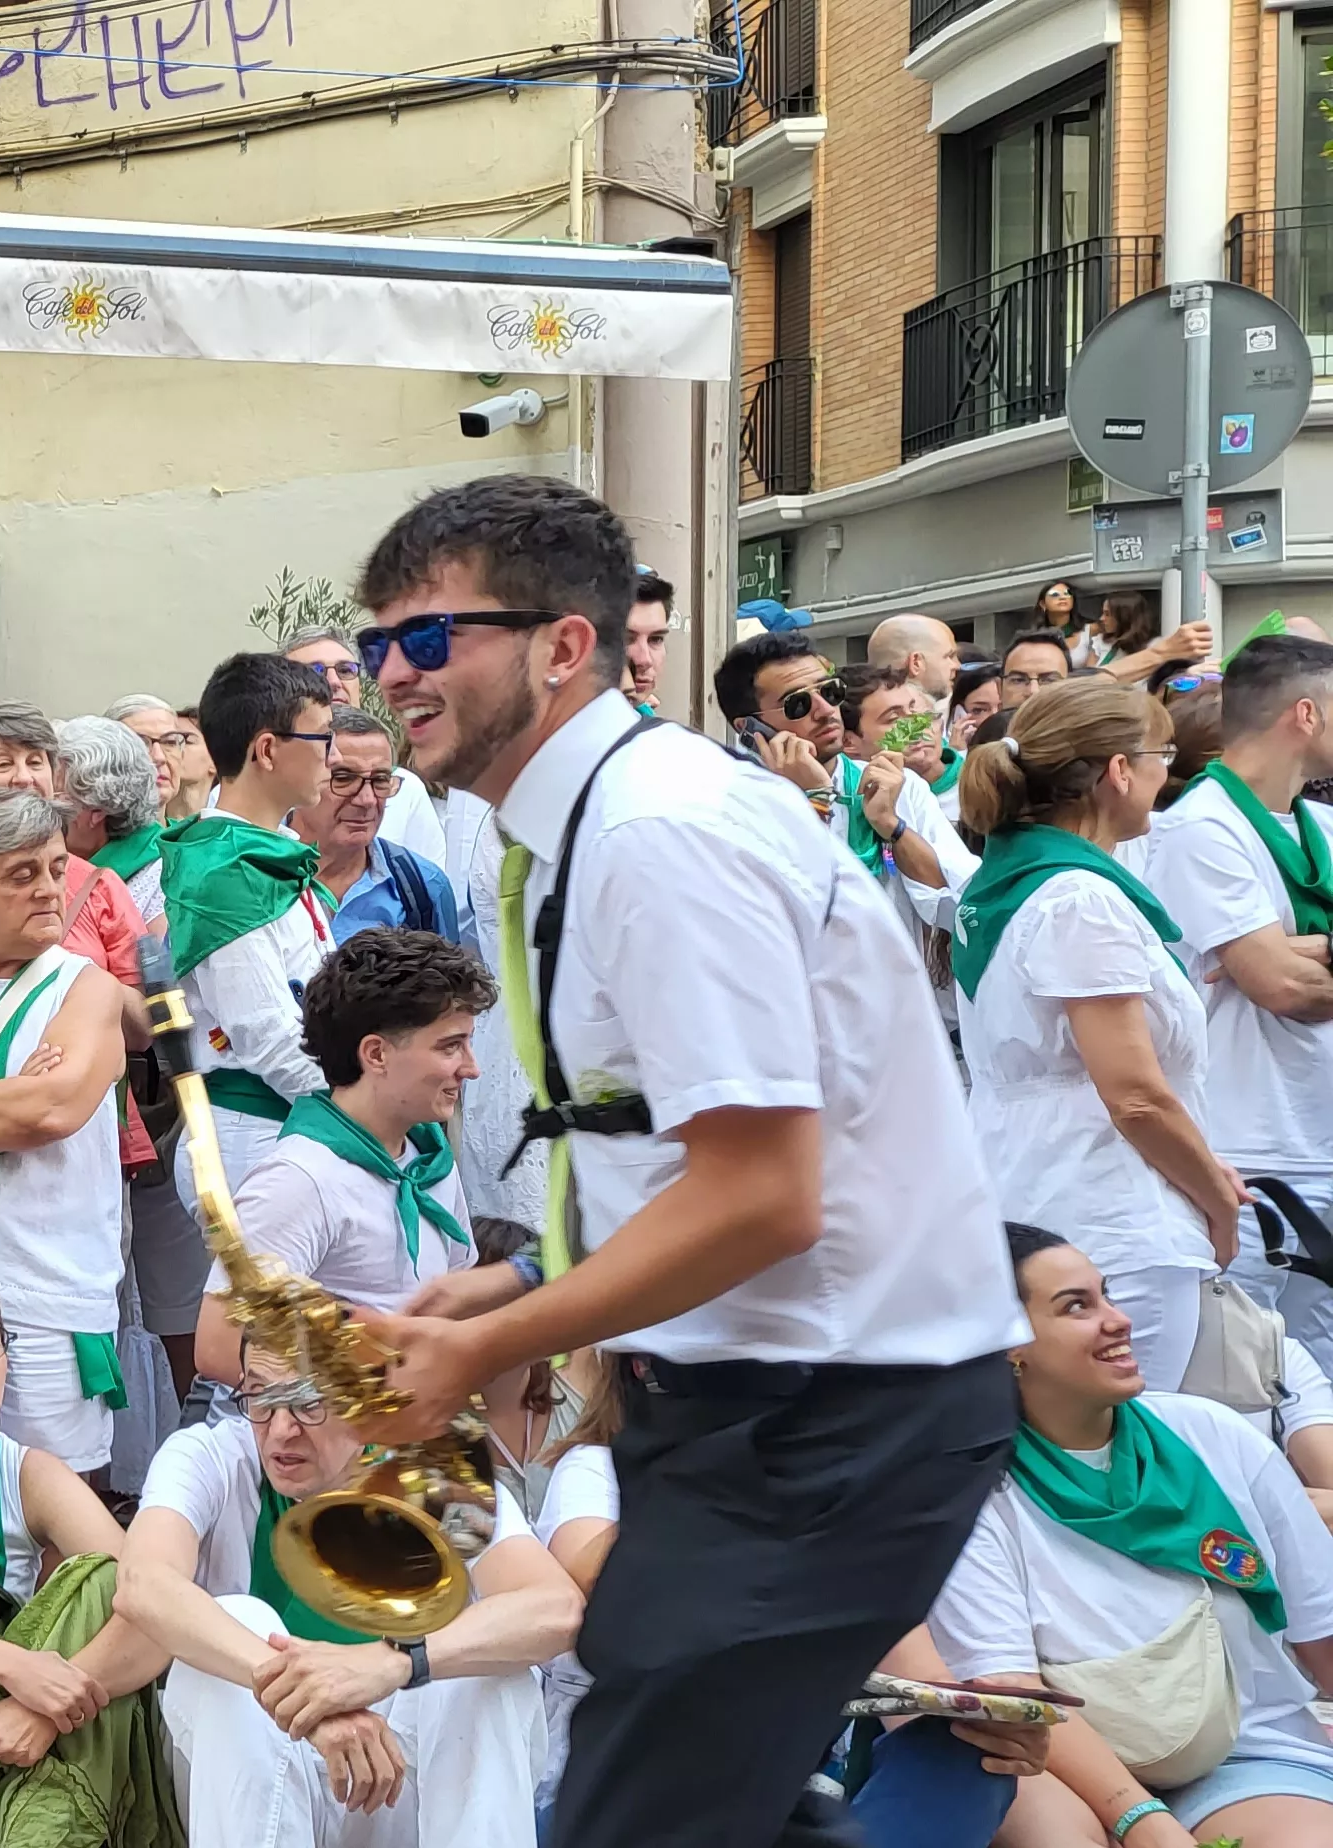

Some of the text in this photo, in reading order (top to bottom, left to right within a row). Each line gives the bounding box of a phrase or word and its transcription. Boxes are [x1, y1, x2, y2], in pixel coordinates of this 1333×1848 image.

[75, 298, 95, 315] del
[97, 286, 148, 334] Sol
[558, 308, 607, 354] Sol
